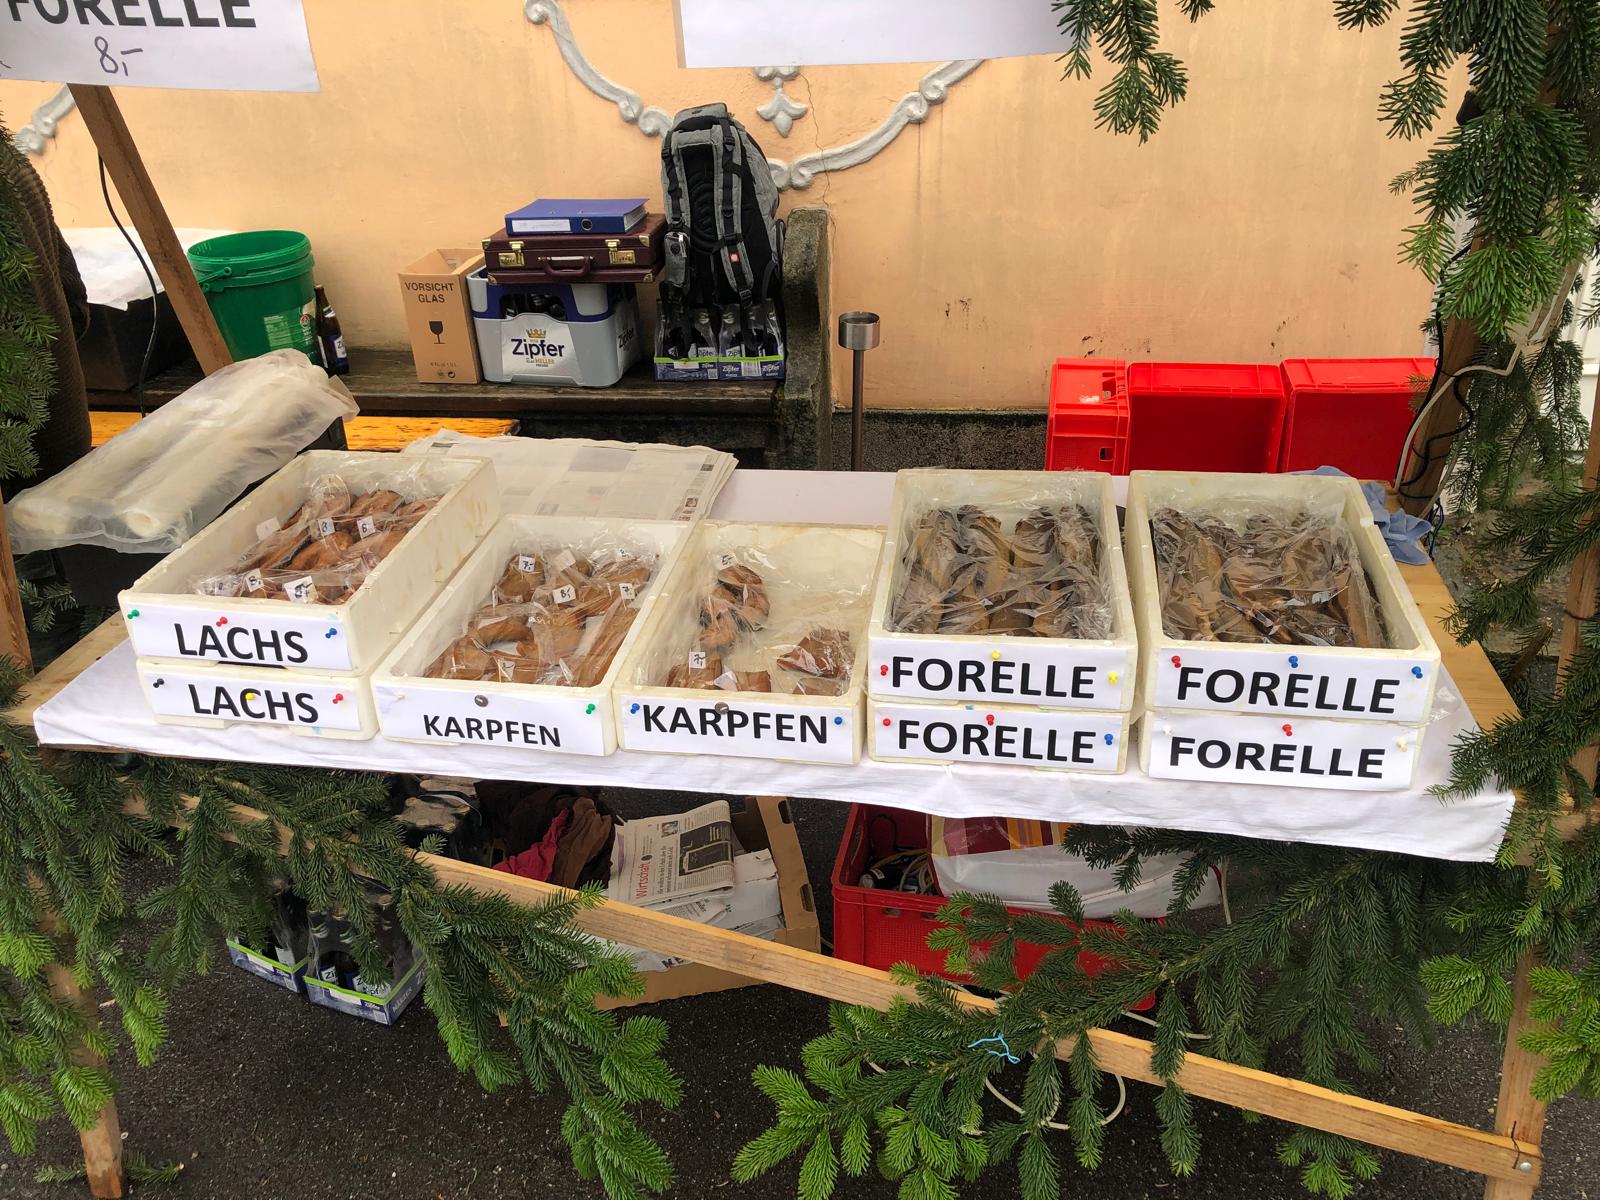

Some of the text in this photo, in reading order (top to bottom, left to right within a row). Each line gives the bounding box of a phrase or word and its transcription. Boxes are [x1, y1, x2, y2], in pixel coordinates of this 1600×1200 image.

[405, 282, 454, 291] VORSICHT
[418, 294, 445, 303] GLAS
[511, 338, 565, 359] Zipfer
[174, 622, 309, 663] LACHS
[892, 656, 1097, 699] FORELLE
[1177, 666, 1400, 714] FORELLE
[188, 683, 319, 724] LACHS
[642, 704, 827, 744] KARPFEN
[423, 714, 561, 748] KARPFEN
[898, 719, 1097, 764] FORELLE
[1170, 736, 1386, 779] FORELLE
